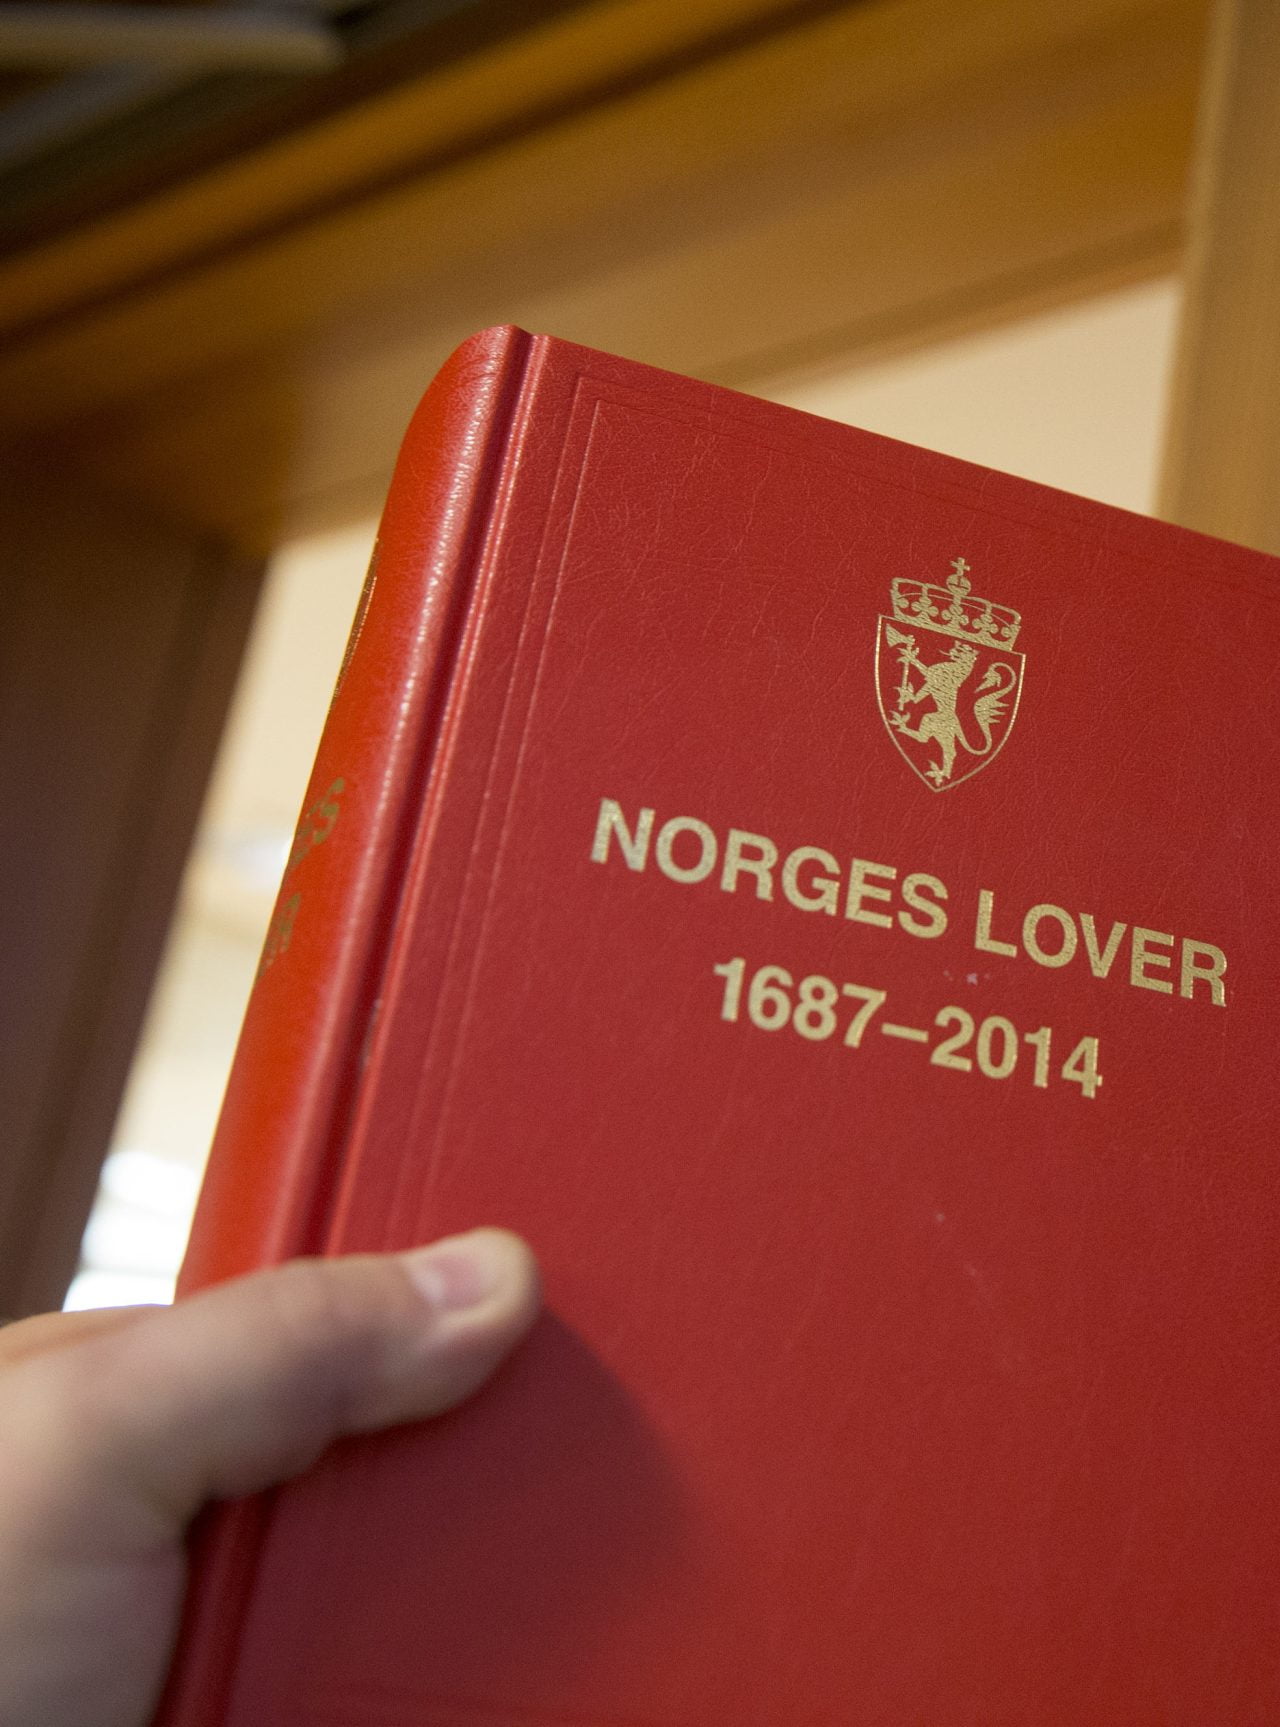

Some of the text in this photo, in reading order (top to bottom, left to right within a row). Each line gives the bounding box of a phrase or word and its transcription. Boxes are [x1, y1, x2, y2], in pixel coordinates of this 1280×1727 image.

[589, 797, 1229, 1008] NORGES LOVER
[713, 956, 1104, 1100] 1687–2014
